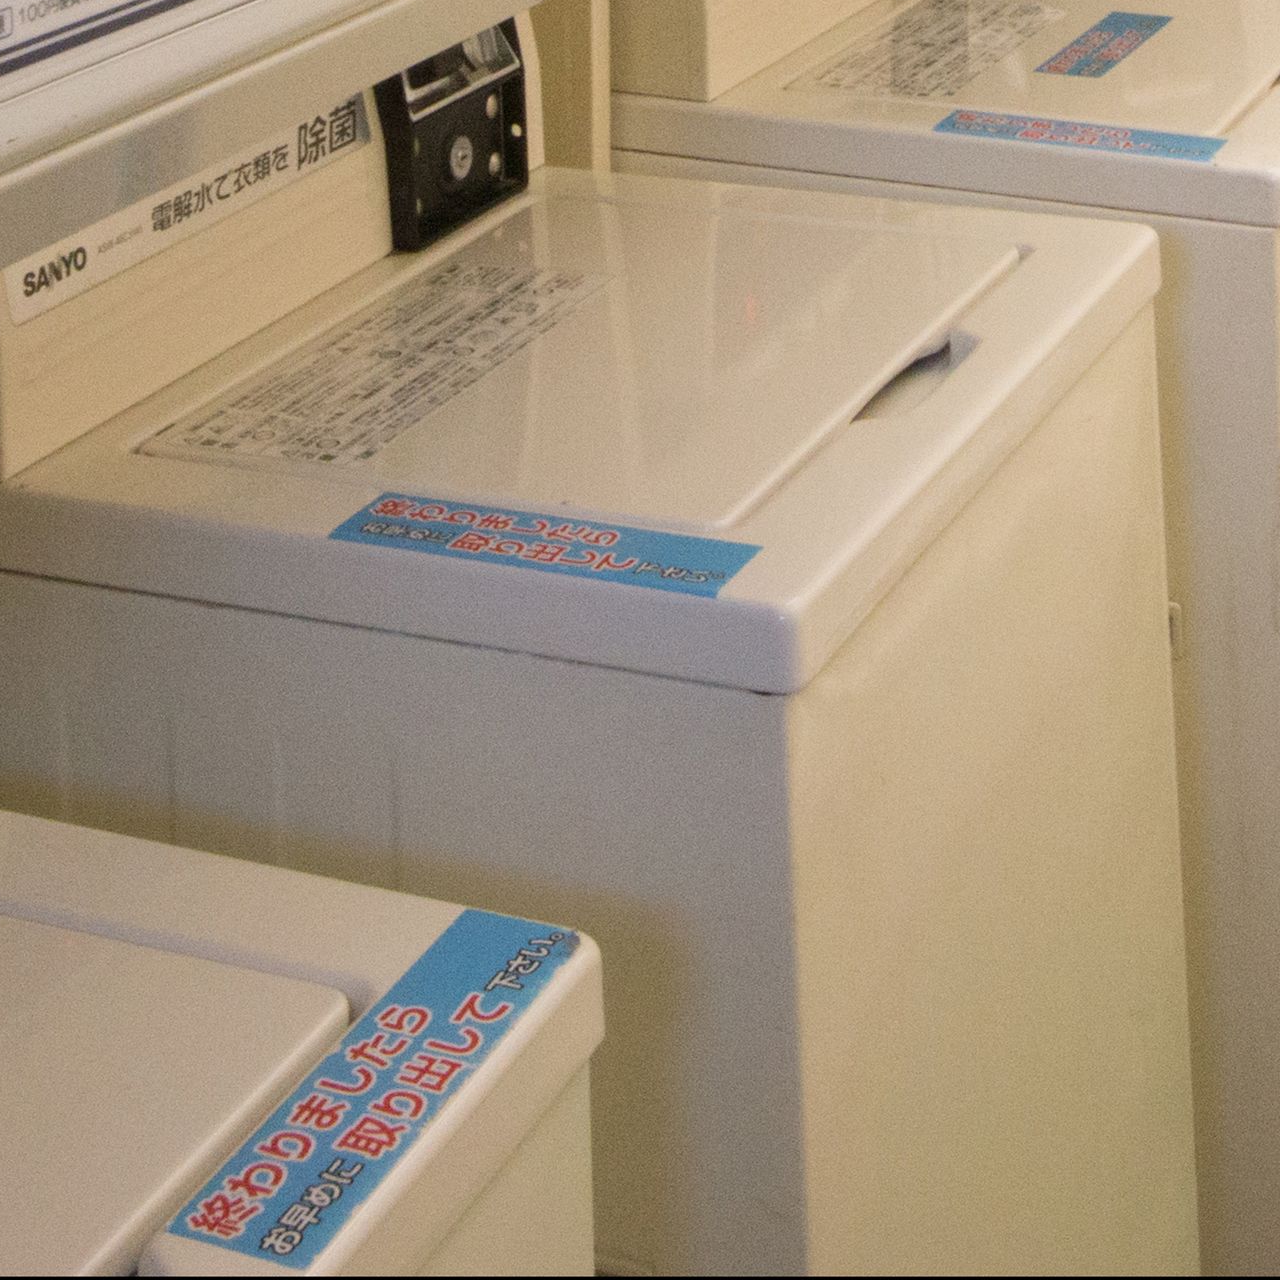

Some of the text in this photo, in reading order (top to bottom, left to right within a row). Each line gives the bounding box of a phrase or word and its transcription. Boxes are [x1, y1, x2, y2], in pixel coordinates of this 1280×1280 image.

[23, 246, 88, 298] SANYO
[296, 99, 358, 172] 除菌
[189, 1004, 431, 1237] 終わりましたら
